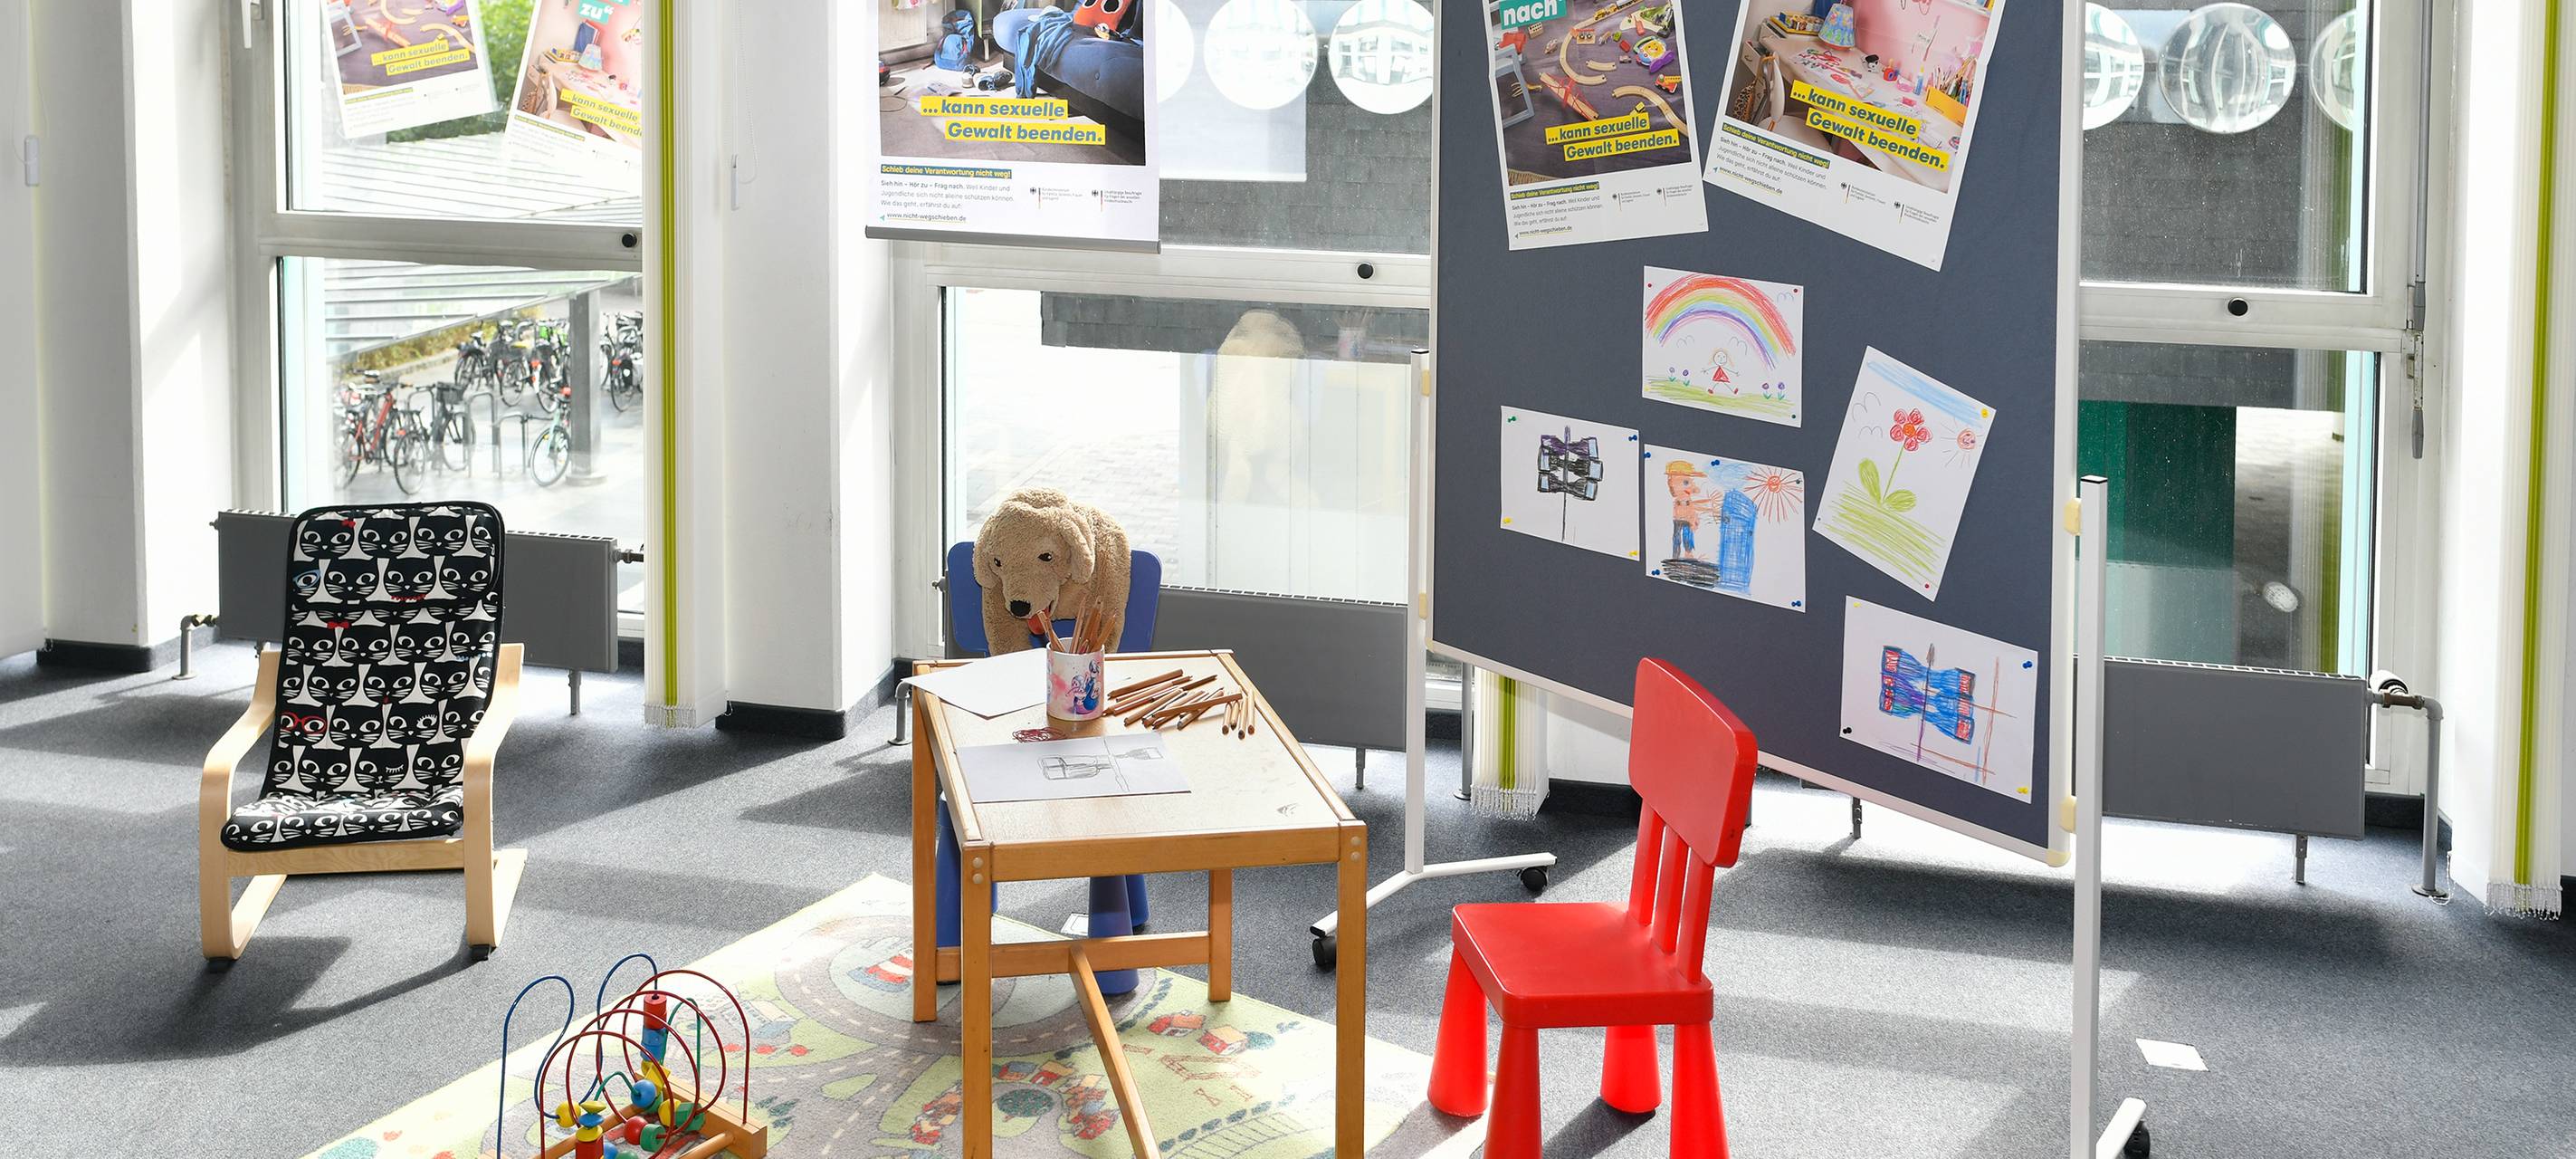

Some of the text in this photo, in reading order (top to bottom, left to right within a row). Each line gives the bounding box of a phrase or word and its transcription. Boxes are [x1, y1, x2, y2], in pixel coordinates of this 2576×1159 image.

[1503, 0, 1562, 25] nach
[408, 43, 446, 55] sexuelle
[389, 53, 468, 72] Gewalt beenden.
[573, 109, 607, 124] Gewalt
[597, 104, 637, 121] sexuelle
[990, 102, 1064, 117] sexuelle
[1594, 117, 1646, 135] sexuelle
[1849, 105, 1916, 135] sexuelle
[948, 120, 1102, 142] Gewalt beenden.
[1809, 111, 1944, 168] Gewalt beenden.
[1567, 134, 1676, 158] Gewalt beenden.
[1798, 152, 1813, 162] nicht
[925, 168, 974, 177] Verantwortung
[994, 170, 1011, 178] weg!
[887, 213, 966, 222] www.nicht-wegschieben.de
